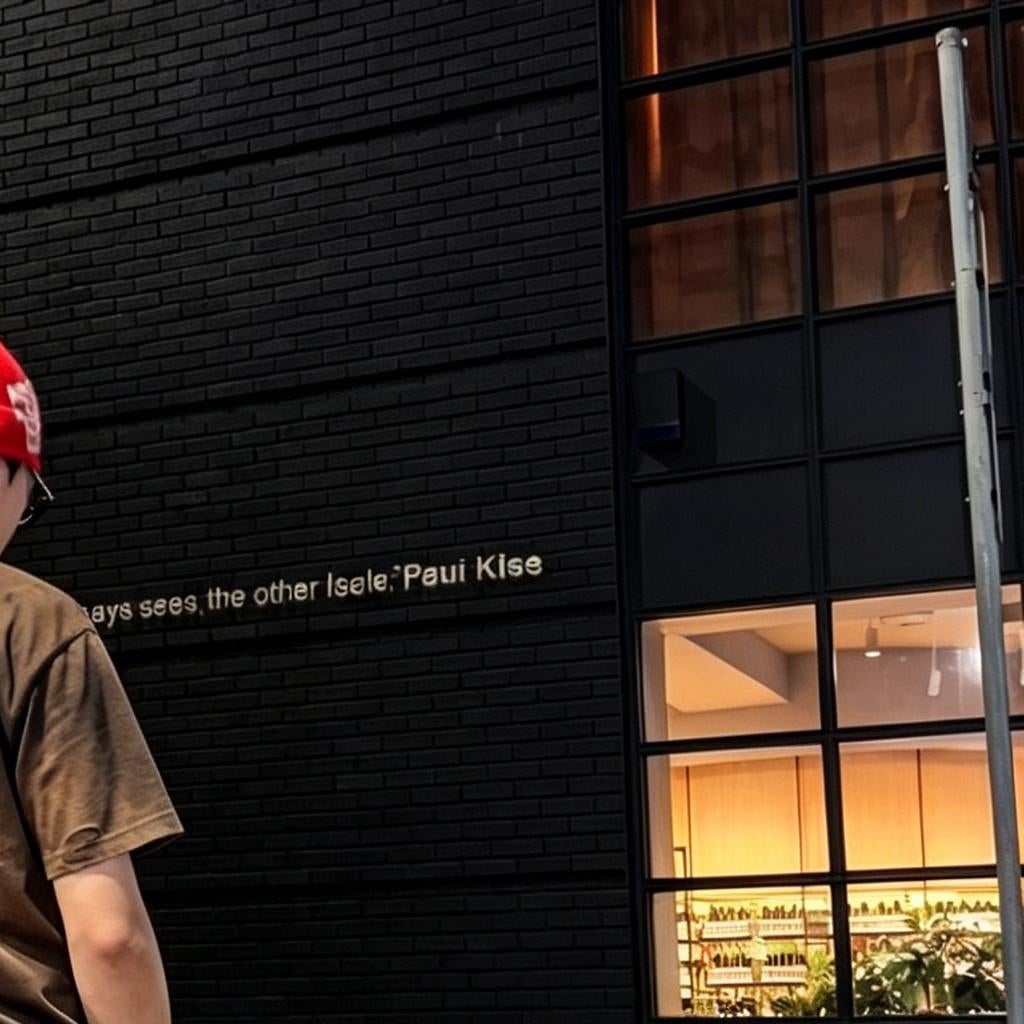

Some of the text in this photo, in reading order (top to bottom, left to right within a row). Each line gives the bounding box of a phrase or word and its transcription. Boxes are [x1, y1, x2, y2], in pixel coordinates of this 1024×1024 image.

[82, 602, 133, 628] ays
[207, 587, 246, 609] the
[253, 578, 320, 605] other
